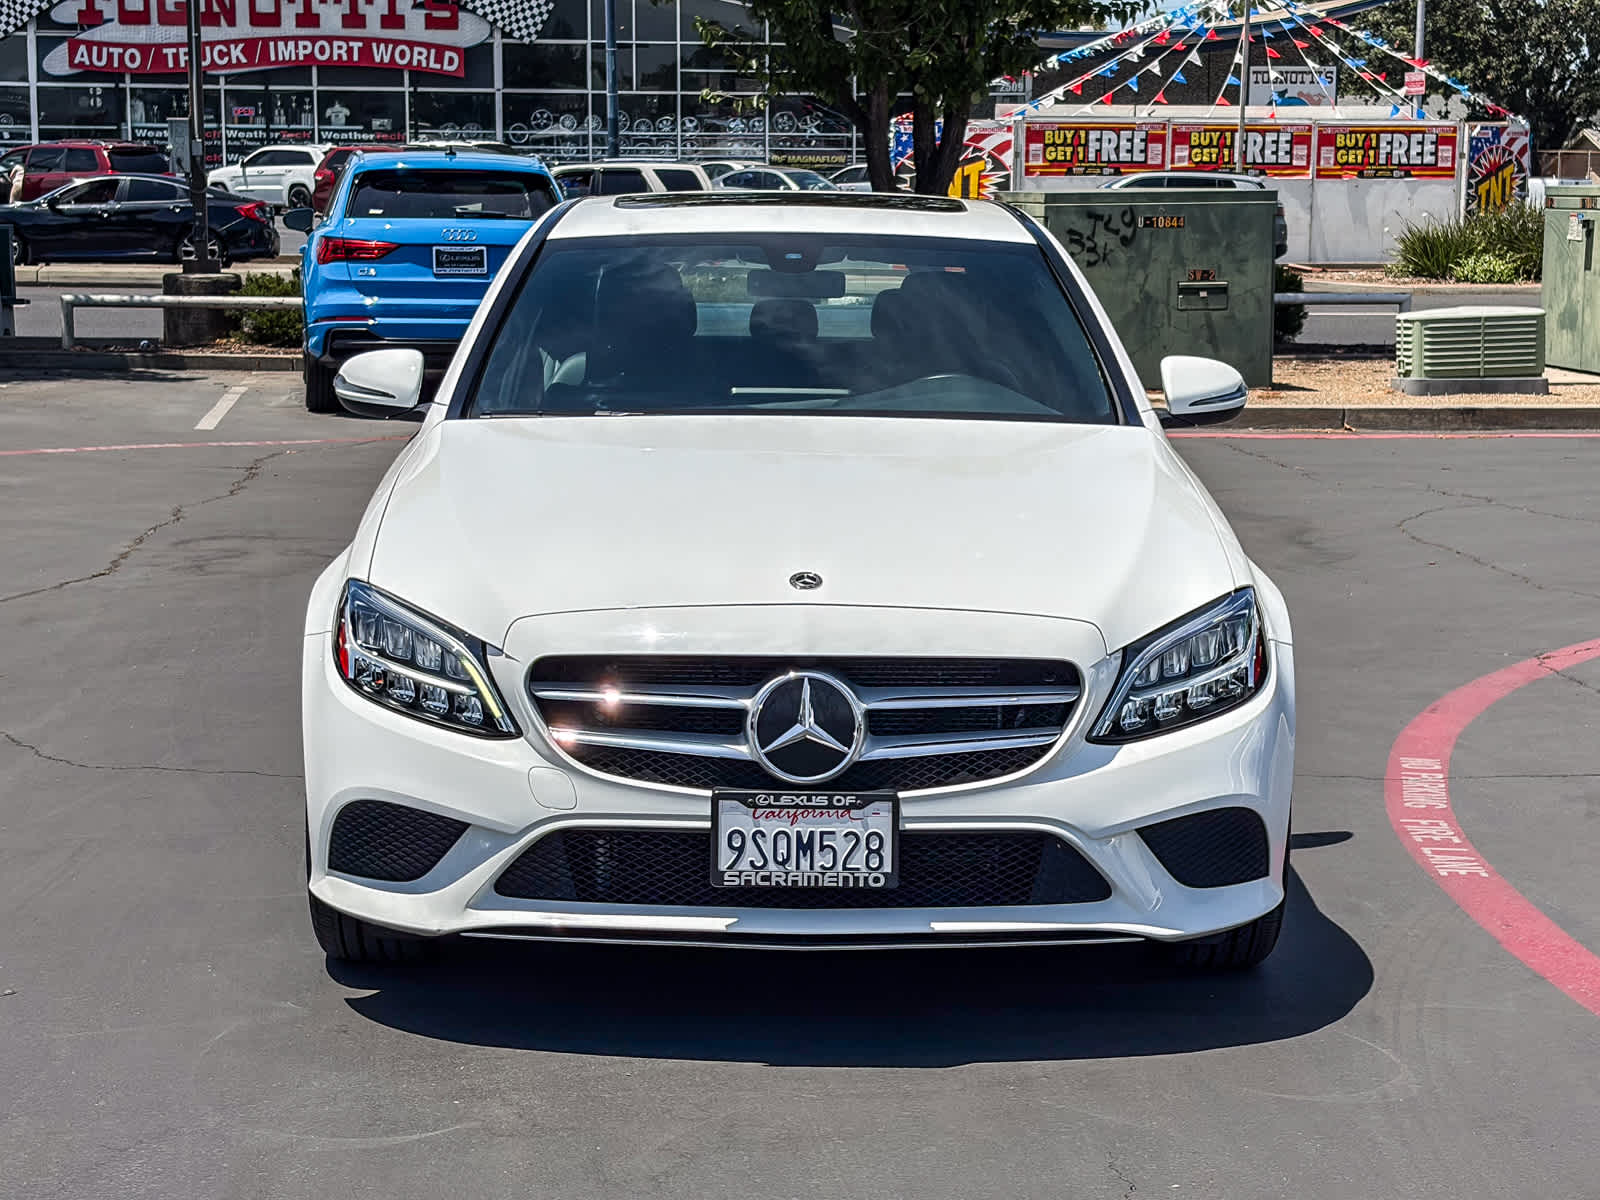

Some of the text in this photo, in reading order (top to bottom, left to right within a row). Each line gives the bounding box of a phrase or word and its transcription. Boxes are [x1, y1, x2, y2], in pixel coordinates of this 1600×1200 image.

[74, 44, 141, 69] AUTO
[269, 40, 363, 62] IMPORT
[372, 42, 460, 72] WORLD
[1044, 130, 1086, 144] BUY 1
[1190, 132, 1231, 146] BUY 1
[1336, 134, 1376, 147] BUY 1
[1088, 130, 1147, 161] FREE
[1234, 132, 1292, 163] FREE
[1378, 134, 1437, 165] FREE
[1045, 147, 1073, 160] GET
[1077, 147, 1084, 160] 1
[1191, 148, 1219, 162] GET
[1223, 148, 1229, 162] 1
[1336, 150, 1364, 163] GET
[1368, 150, 1375, 163] 1
[1478, 163, 1515, 216] TNT
[1188, 270, 1216, 281] SW-2
[768, 795, 856, 806] LEXUS OF
[752, 808, 865, 826] California
[726, 829, 885, 871] 9SQM528
[723, 871, 886, 887] SACRAMENTO
